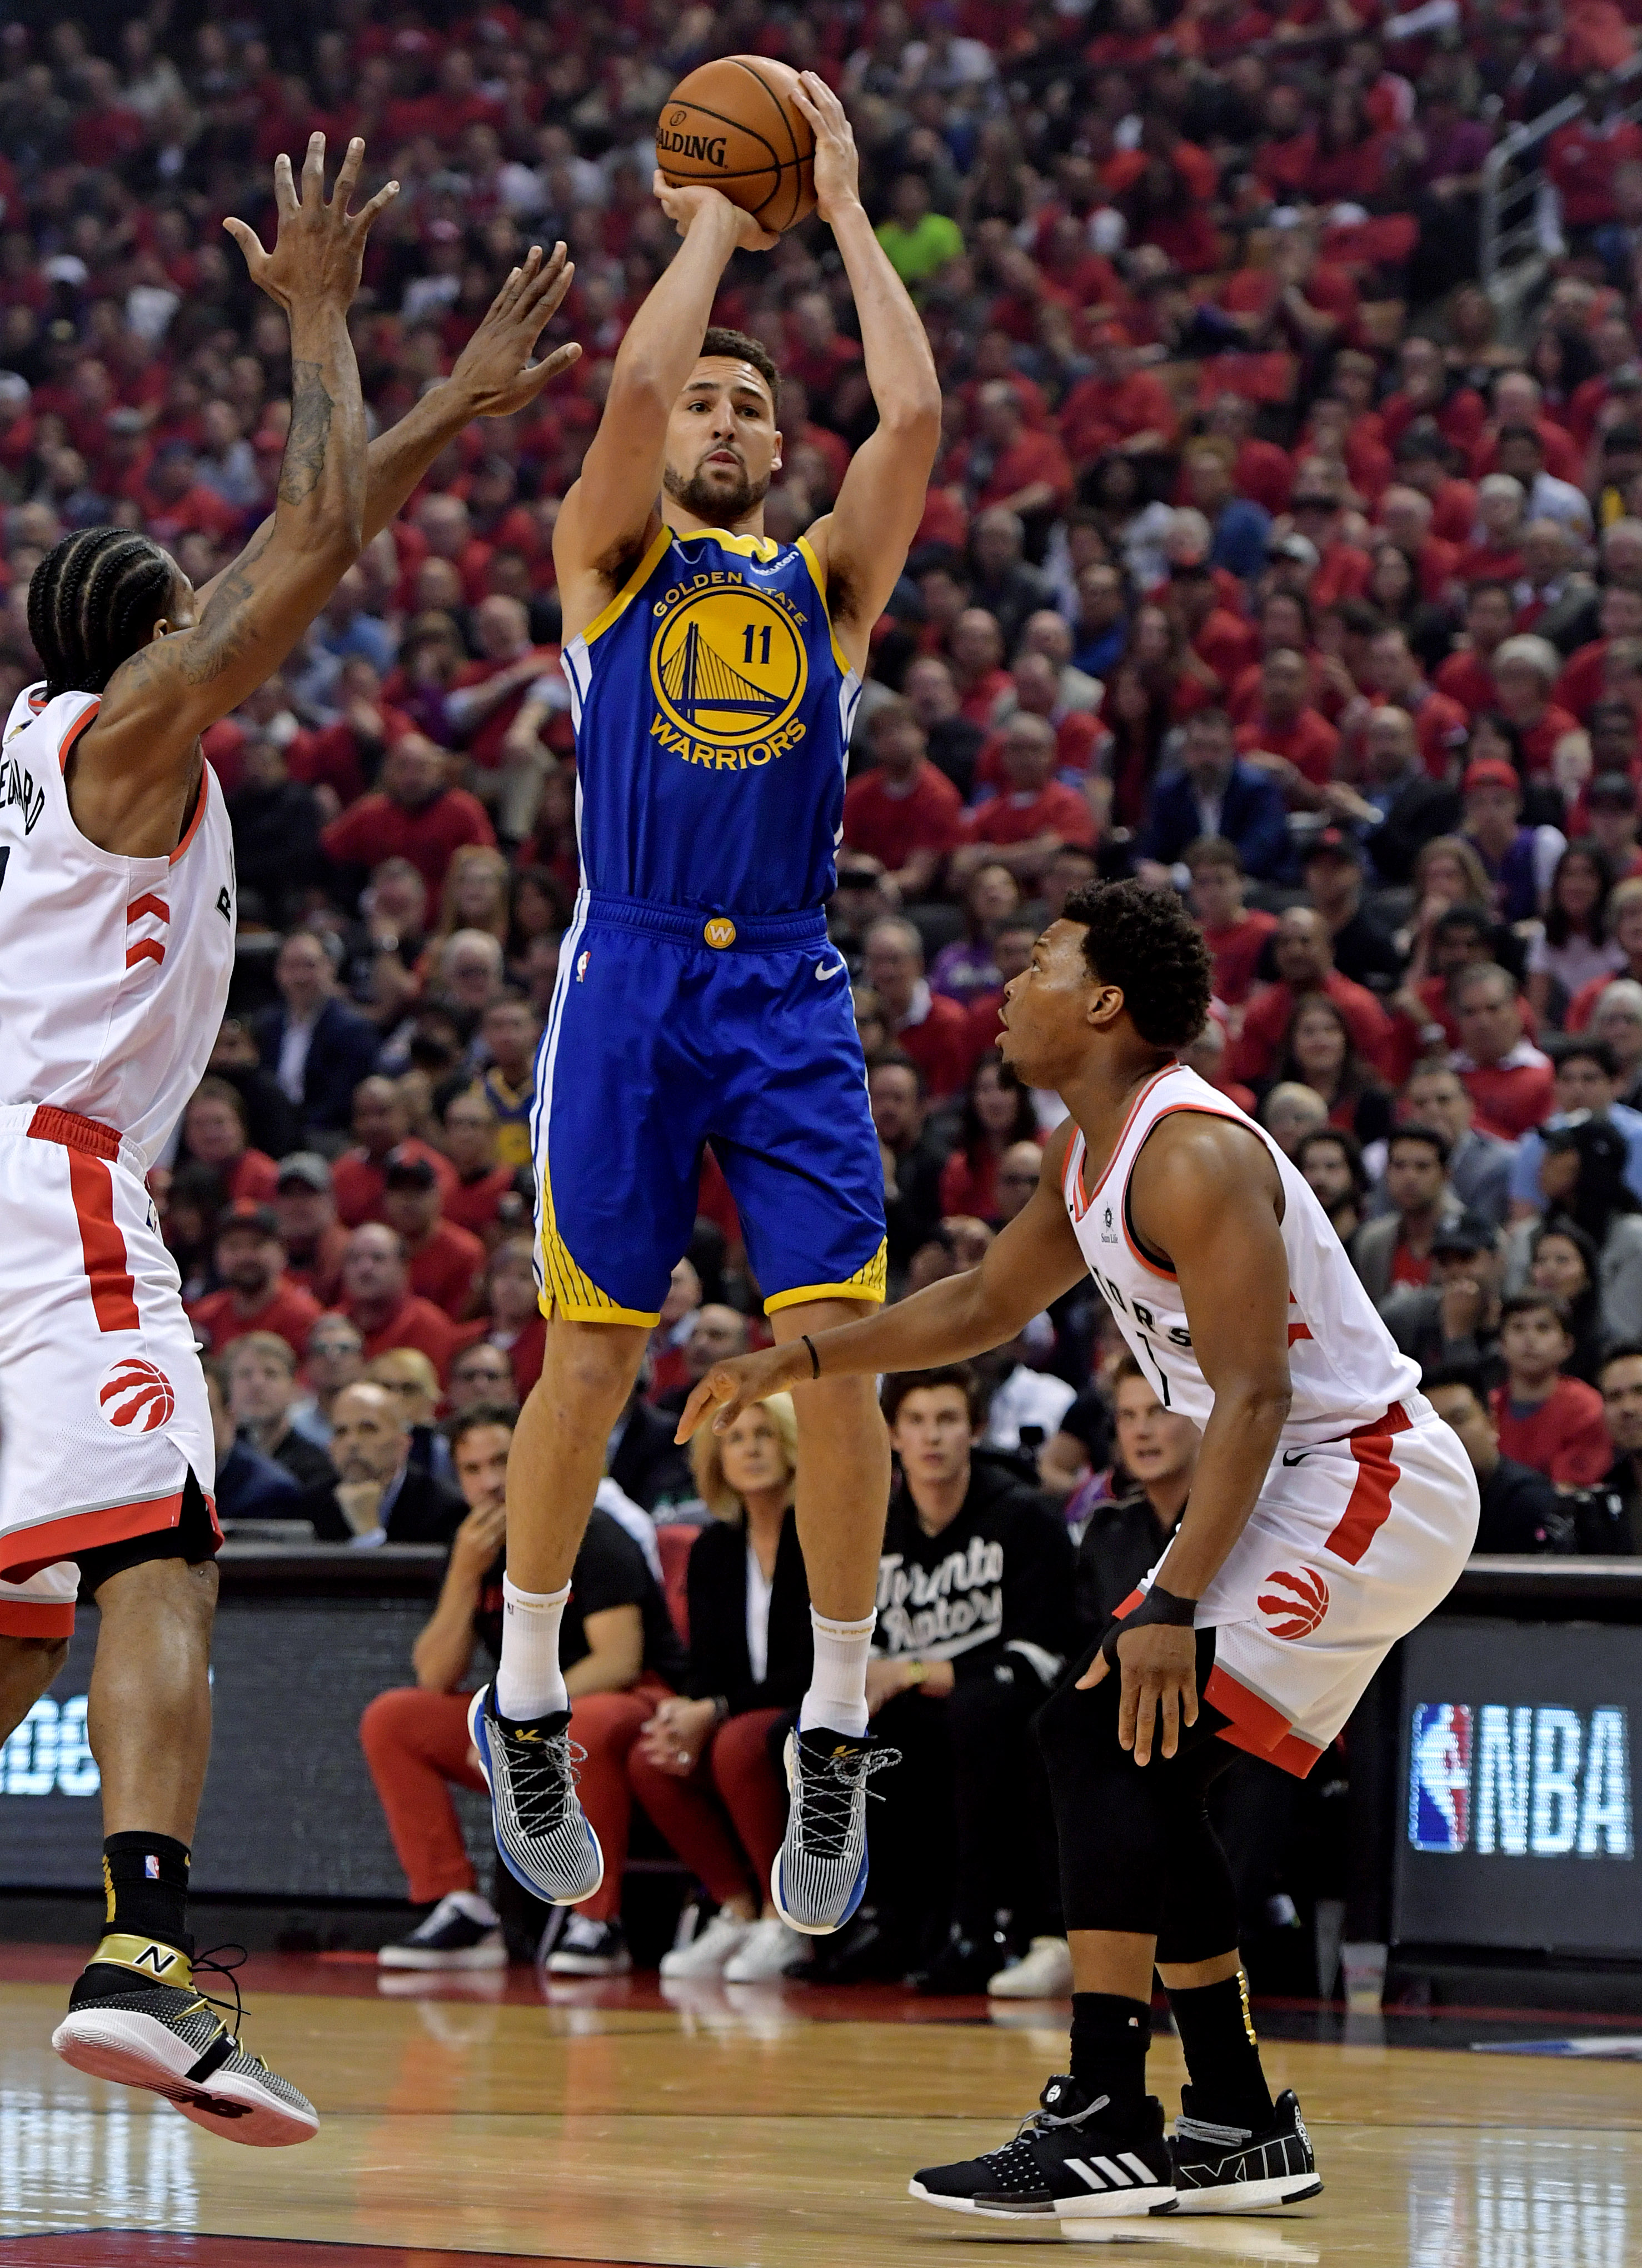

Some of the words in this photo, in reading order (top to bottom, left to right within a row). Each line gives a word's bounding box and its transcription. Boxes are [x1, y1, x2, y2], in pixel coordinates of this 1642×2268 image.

[656, 128, 727, 167] ALDING
[653, 571, 742, 617] GOLDEN
[742, 624, 772, 664] 11
[649, 712, 807, 771] WARRIORS
[1476, 1703, 1633, 1858] NBA
